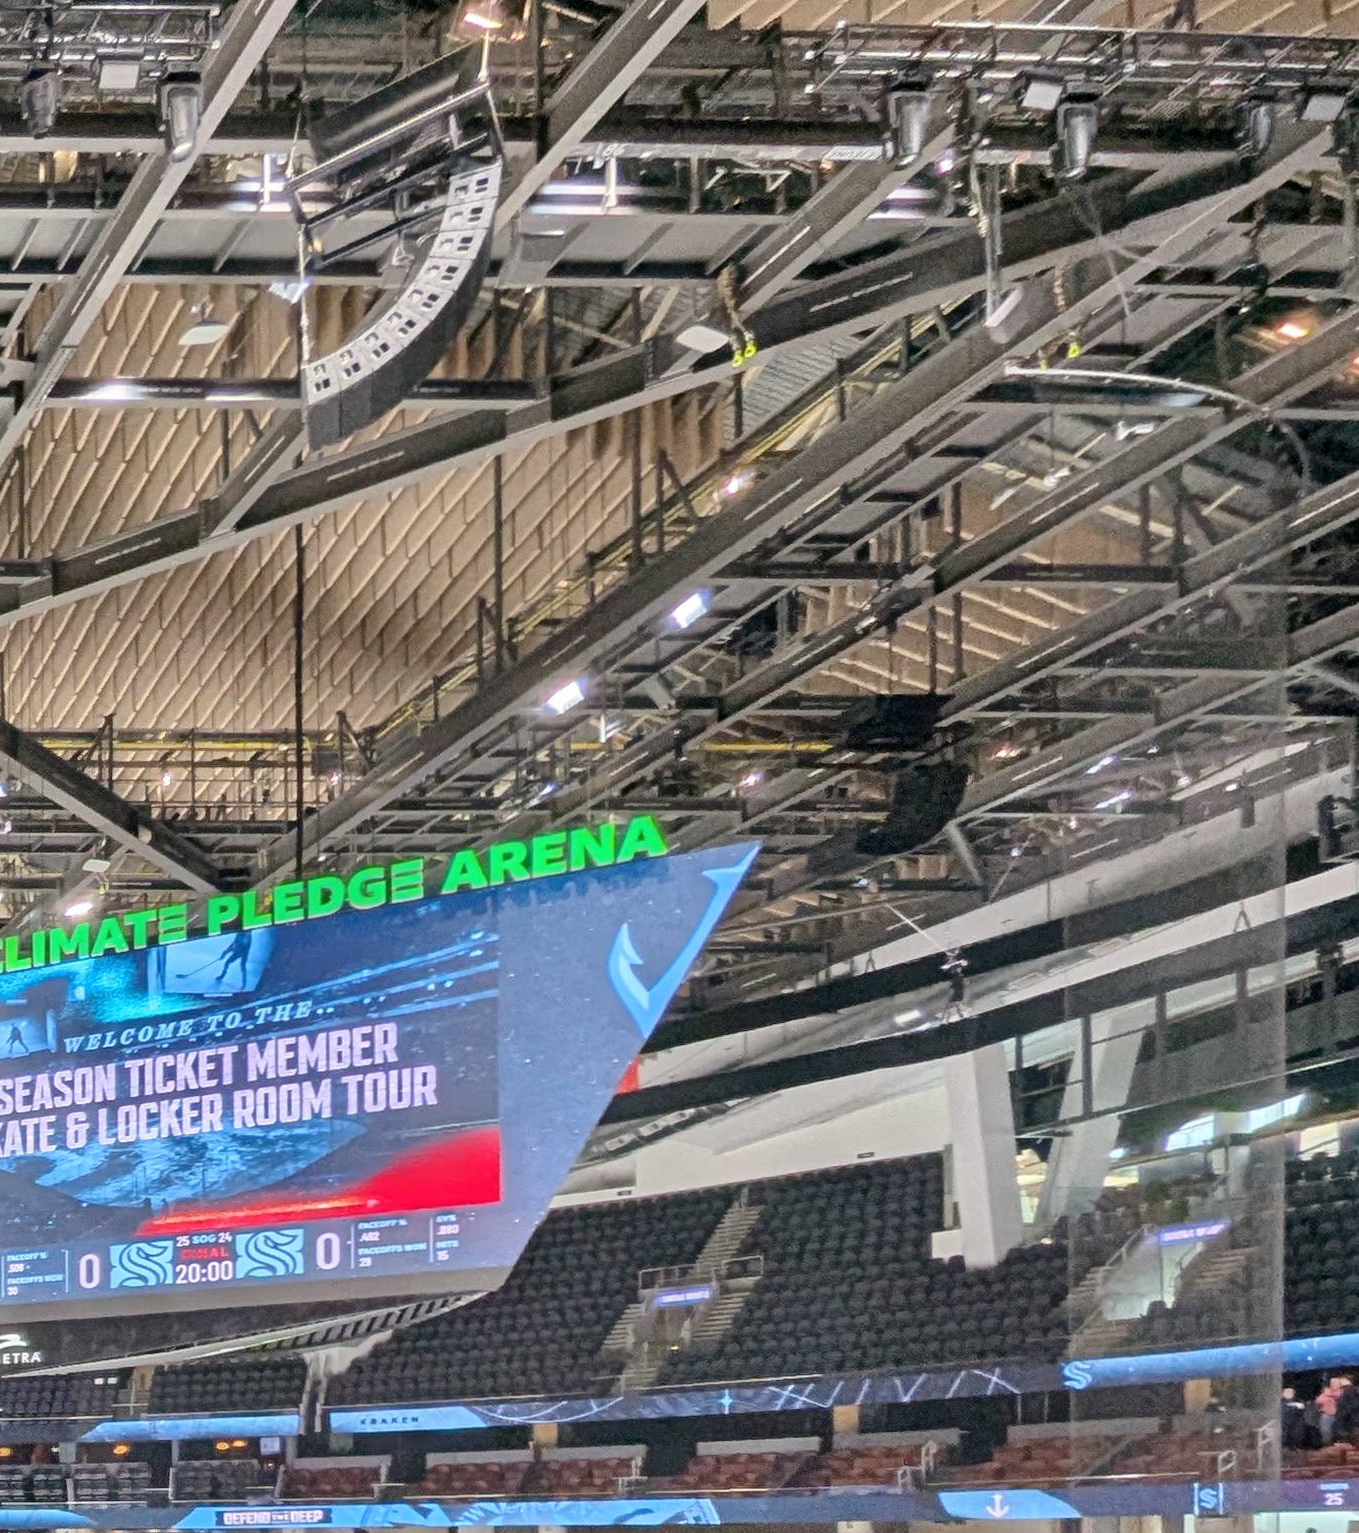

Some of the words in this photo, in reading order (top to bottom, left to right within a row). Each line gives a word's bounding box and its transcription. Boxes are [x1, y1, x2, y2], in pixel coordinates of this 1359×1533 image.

[207, 859, 425, 934] PLEDGE
[440, 815, 668, 895] ARENA
[63, 1015, 201, 1054] WELCOME
[208, 1008, 243, 1032] TO
[124, 1045, 239, 1098] TICKET
[246, 1022, 398, 1078] MEMBER
[65, 1113, 89, 1147] &
[97, 1095, 223, 1144] LOCKER
[232, 1077, 333, 1128] ROOM
[343, 1064, 439, 1114] TOUR
[176, 1236, 189, 1248] 25
[191, 1234, 216, 1246] SOG
[218, 1231, 232, 1244] 24
[358, 1219, 395, 1232] FACEOFF
[315, 1232, 341, 1270] 0
[79, 1254, 101, 1289] 0
[176, 1260, 233, 1285] 20:00
[1324, 1491, 1345, 1507] 25
[224, 1510, 270, 1525] DEFEND
[291, 1510, 323, 1525] DEEP
